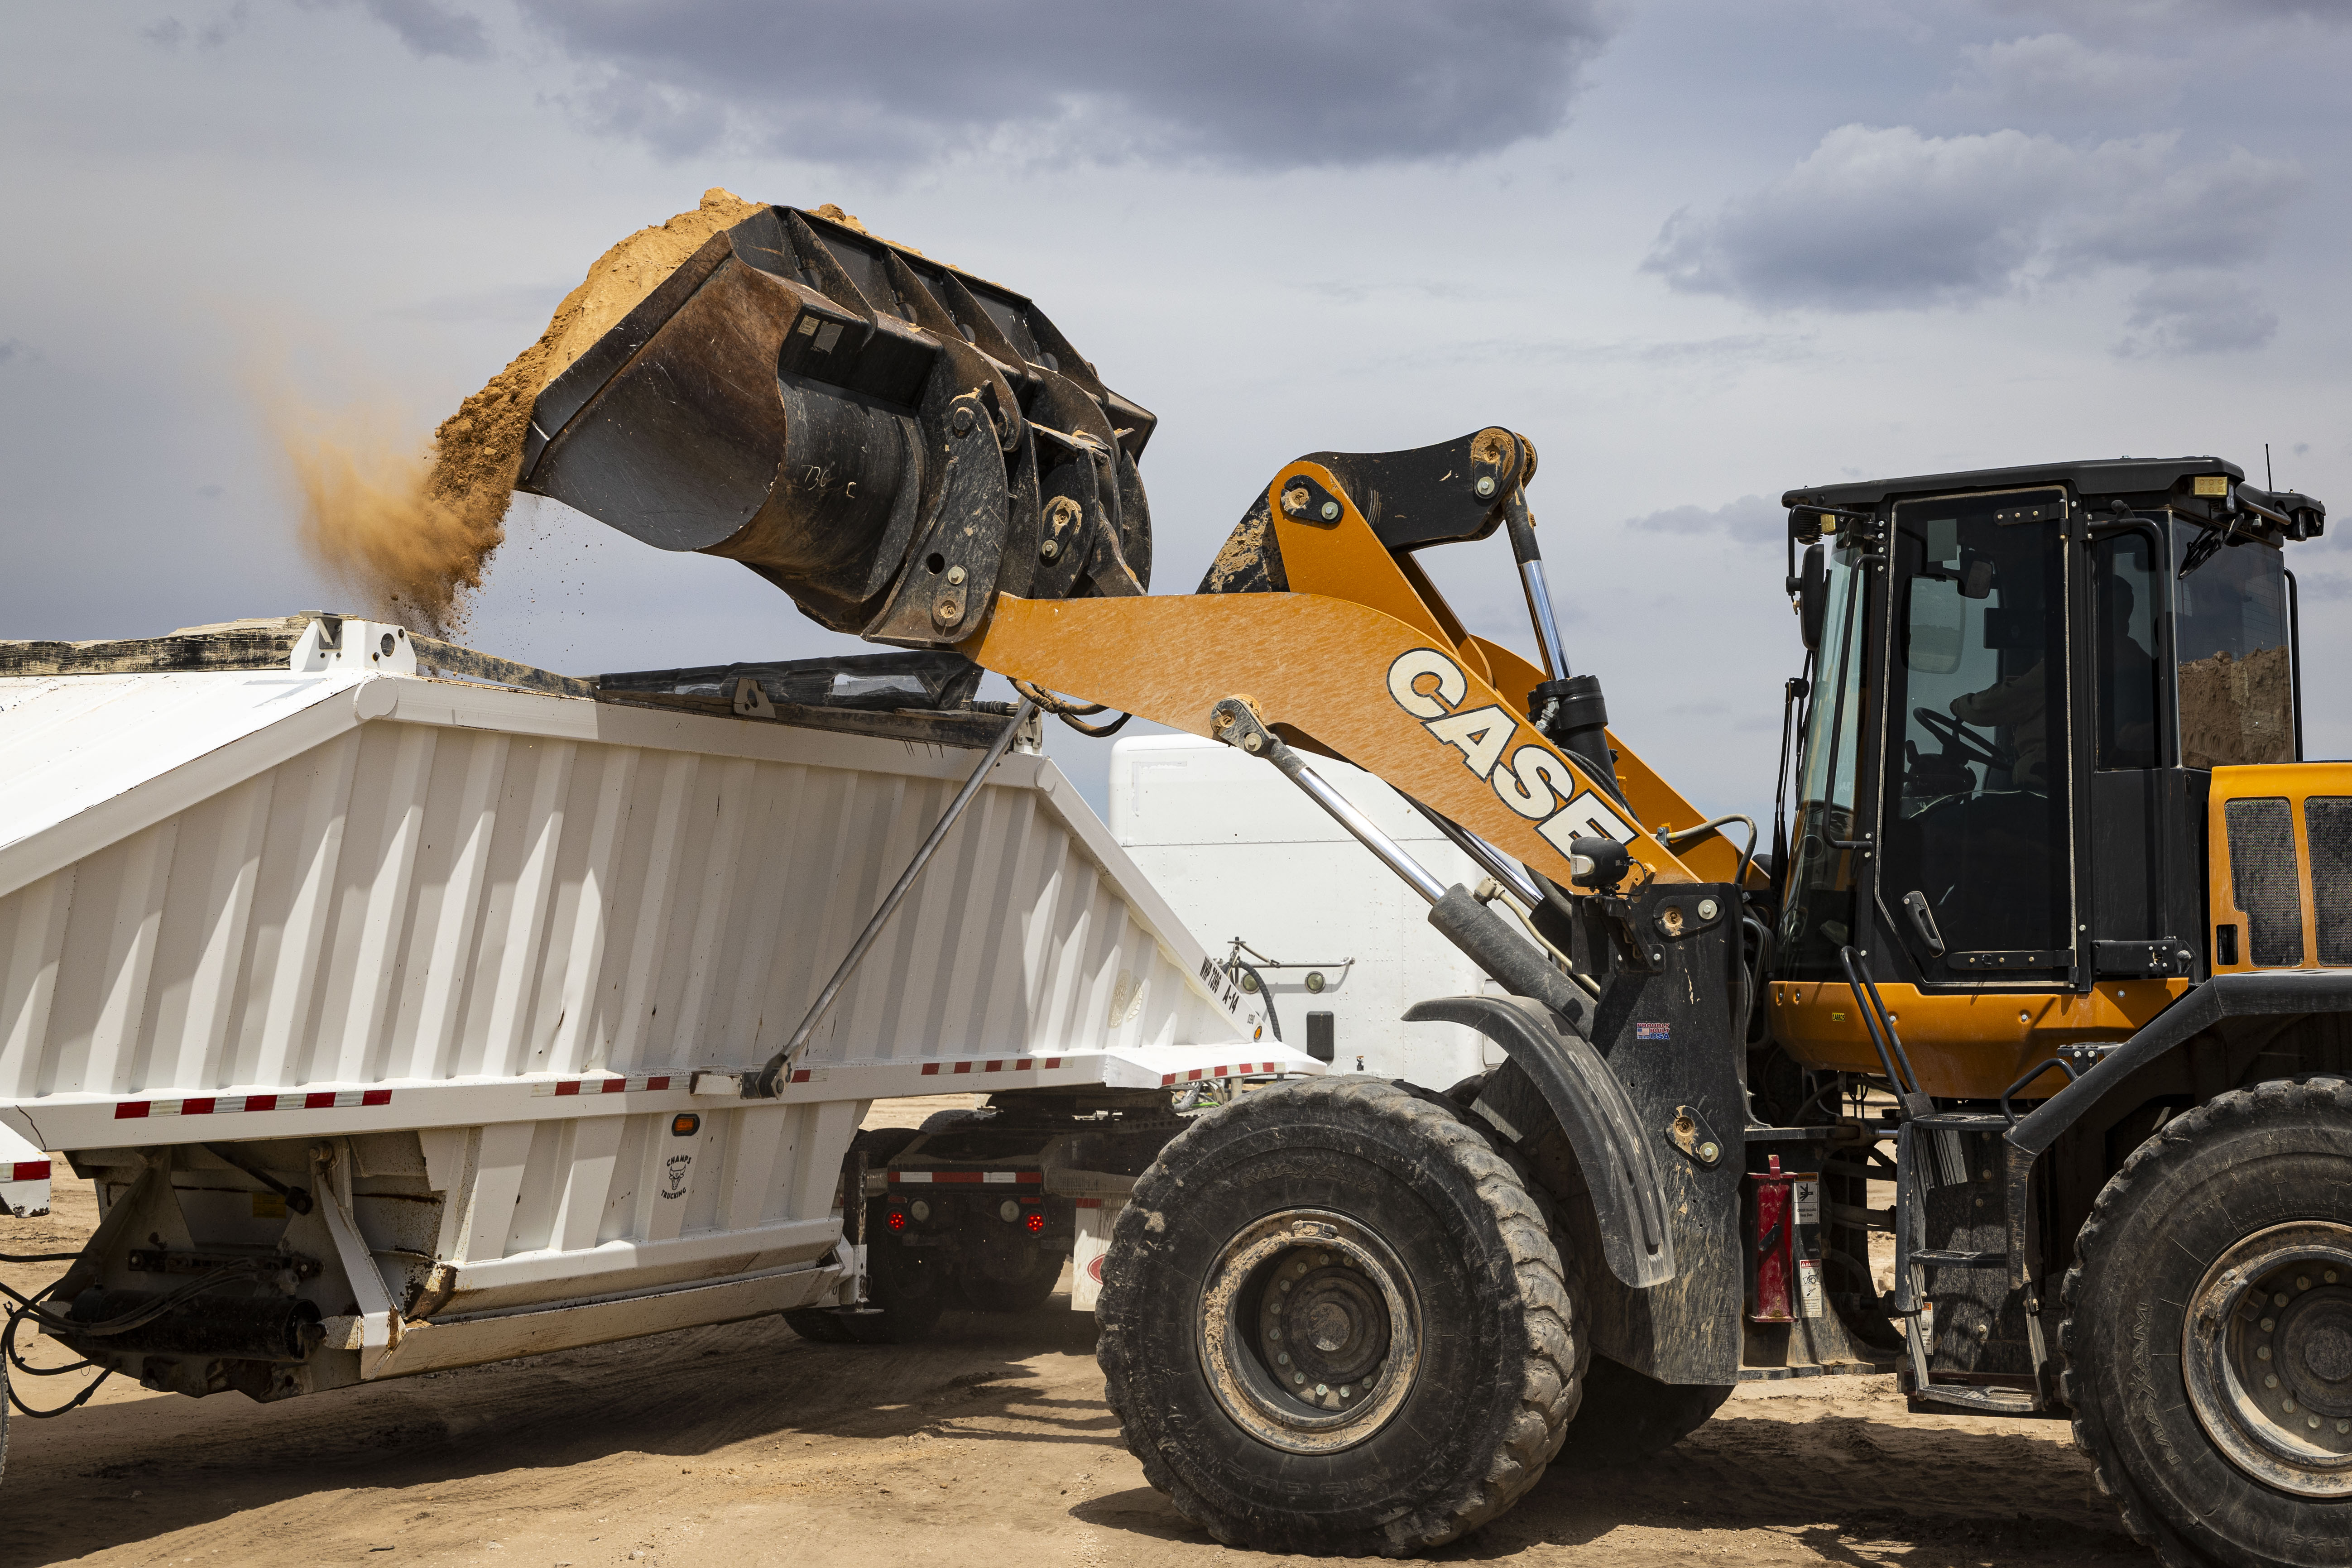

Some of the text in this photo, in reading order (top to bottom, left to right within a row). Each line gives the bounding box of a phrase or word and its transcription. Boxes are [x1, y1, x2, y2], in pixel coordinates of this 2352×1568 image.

[1386, 647, 1640, 860] CASE
[1200, 956, 1222, 993] WHP 7396
[1222, 984, 1239, 1014] A-14
[667, 1154, 691, 1167] CHAMPS
[1241, 1160, 1378, 1194] MAXAM
[661, 1187, 686, 1199] TRUCKING
[2130, 1302, 2182, 1467] MAXAM
